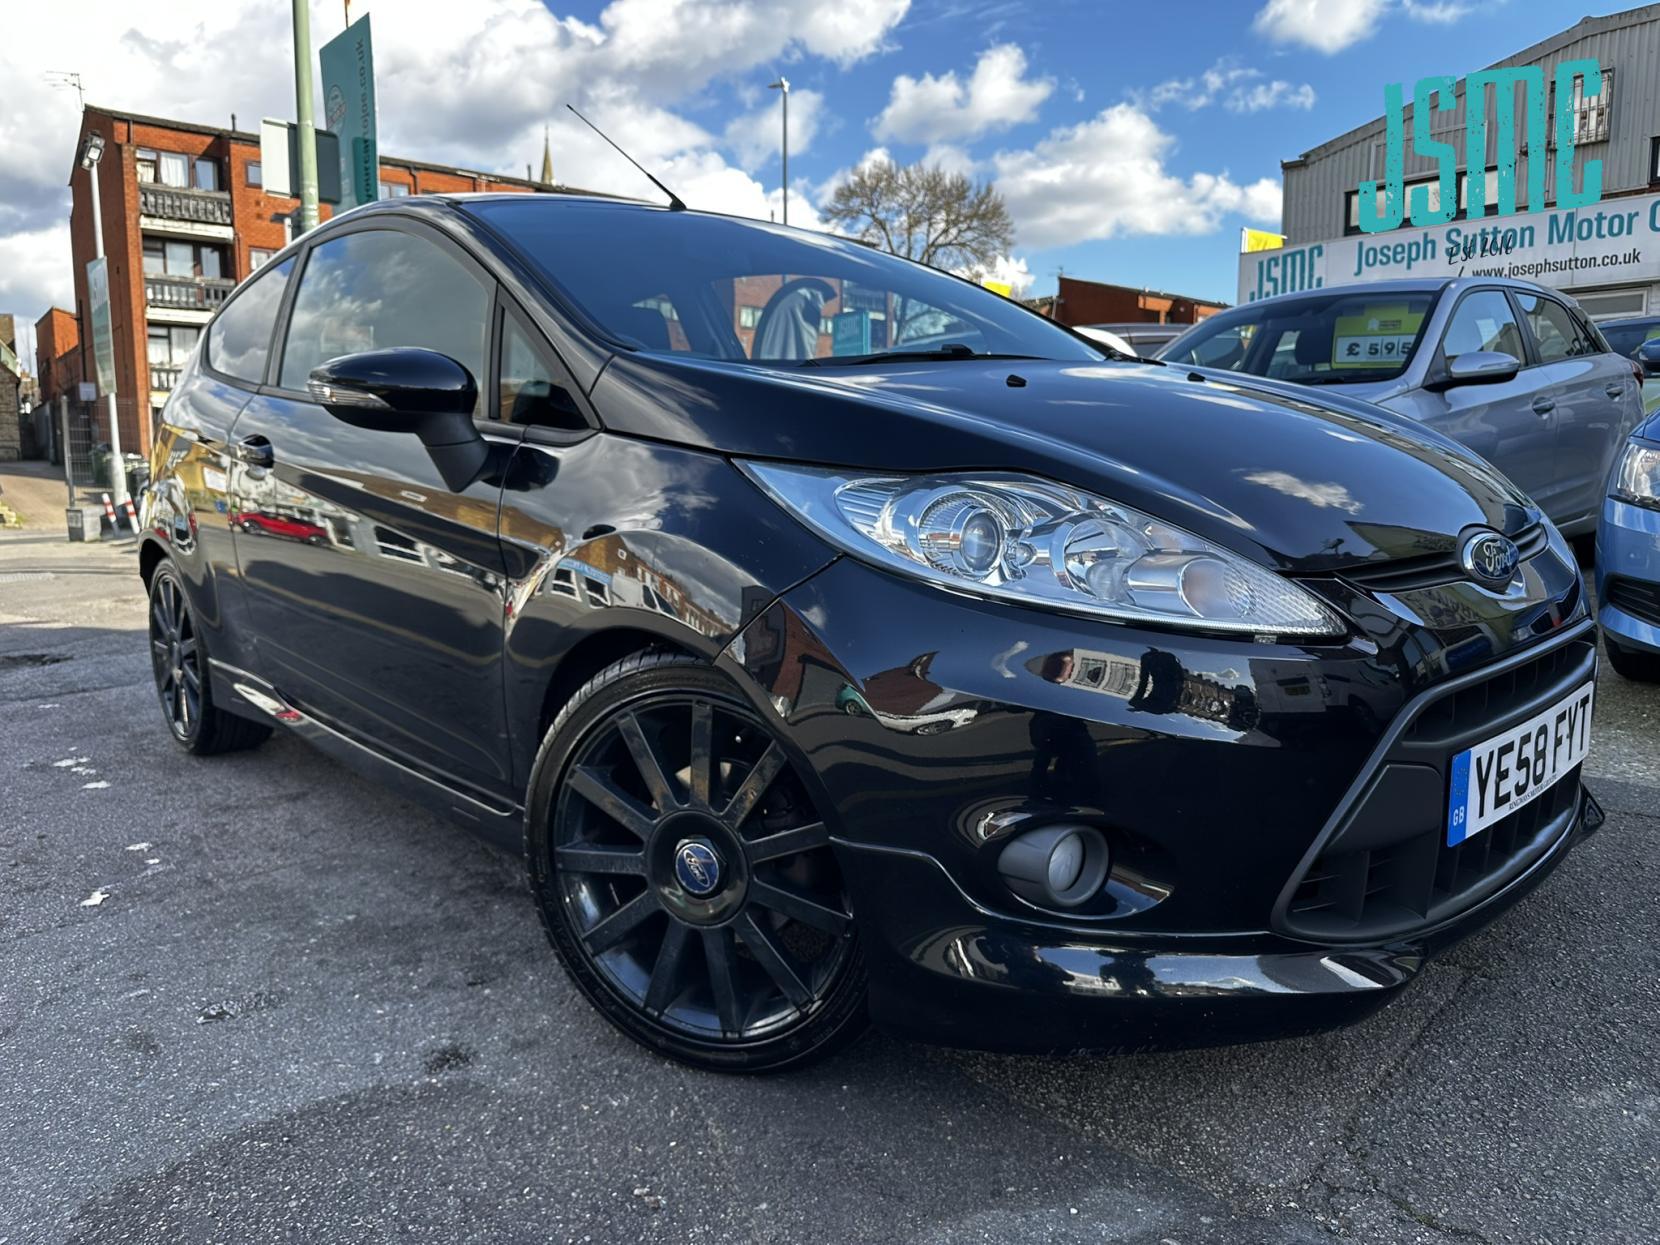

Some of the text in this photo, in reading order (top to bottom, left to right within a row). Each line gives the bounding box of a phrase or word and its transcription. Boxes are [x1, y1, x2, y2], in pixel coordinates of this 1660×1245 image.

[1354, 232, 1437, 276] Joseph
[1444, 223, 1535, 257] Sutton
[1546, 210, 1639, 245] Motor
[1472, 248, 1641, 279] www.josephsutton.co.uk
[1249, 244, 1323, 302] JSMC
[1483, 541, 1512, 572] Ford
[1475, 723, 1549, 819] YE58
[1552, 693, 1590, 773] FYT
[1452, 806, 1465, 827] GB
